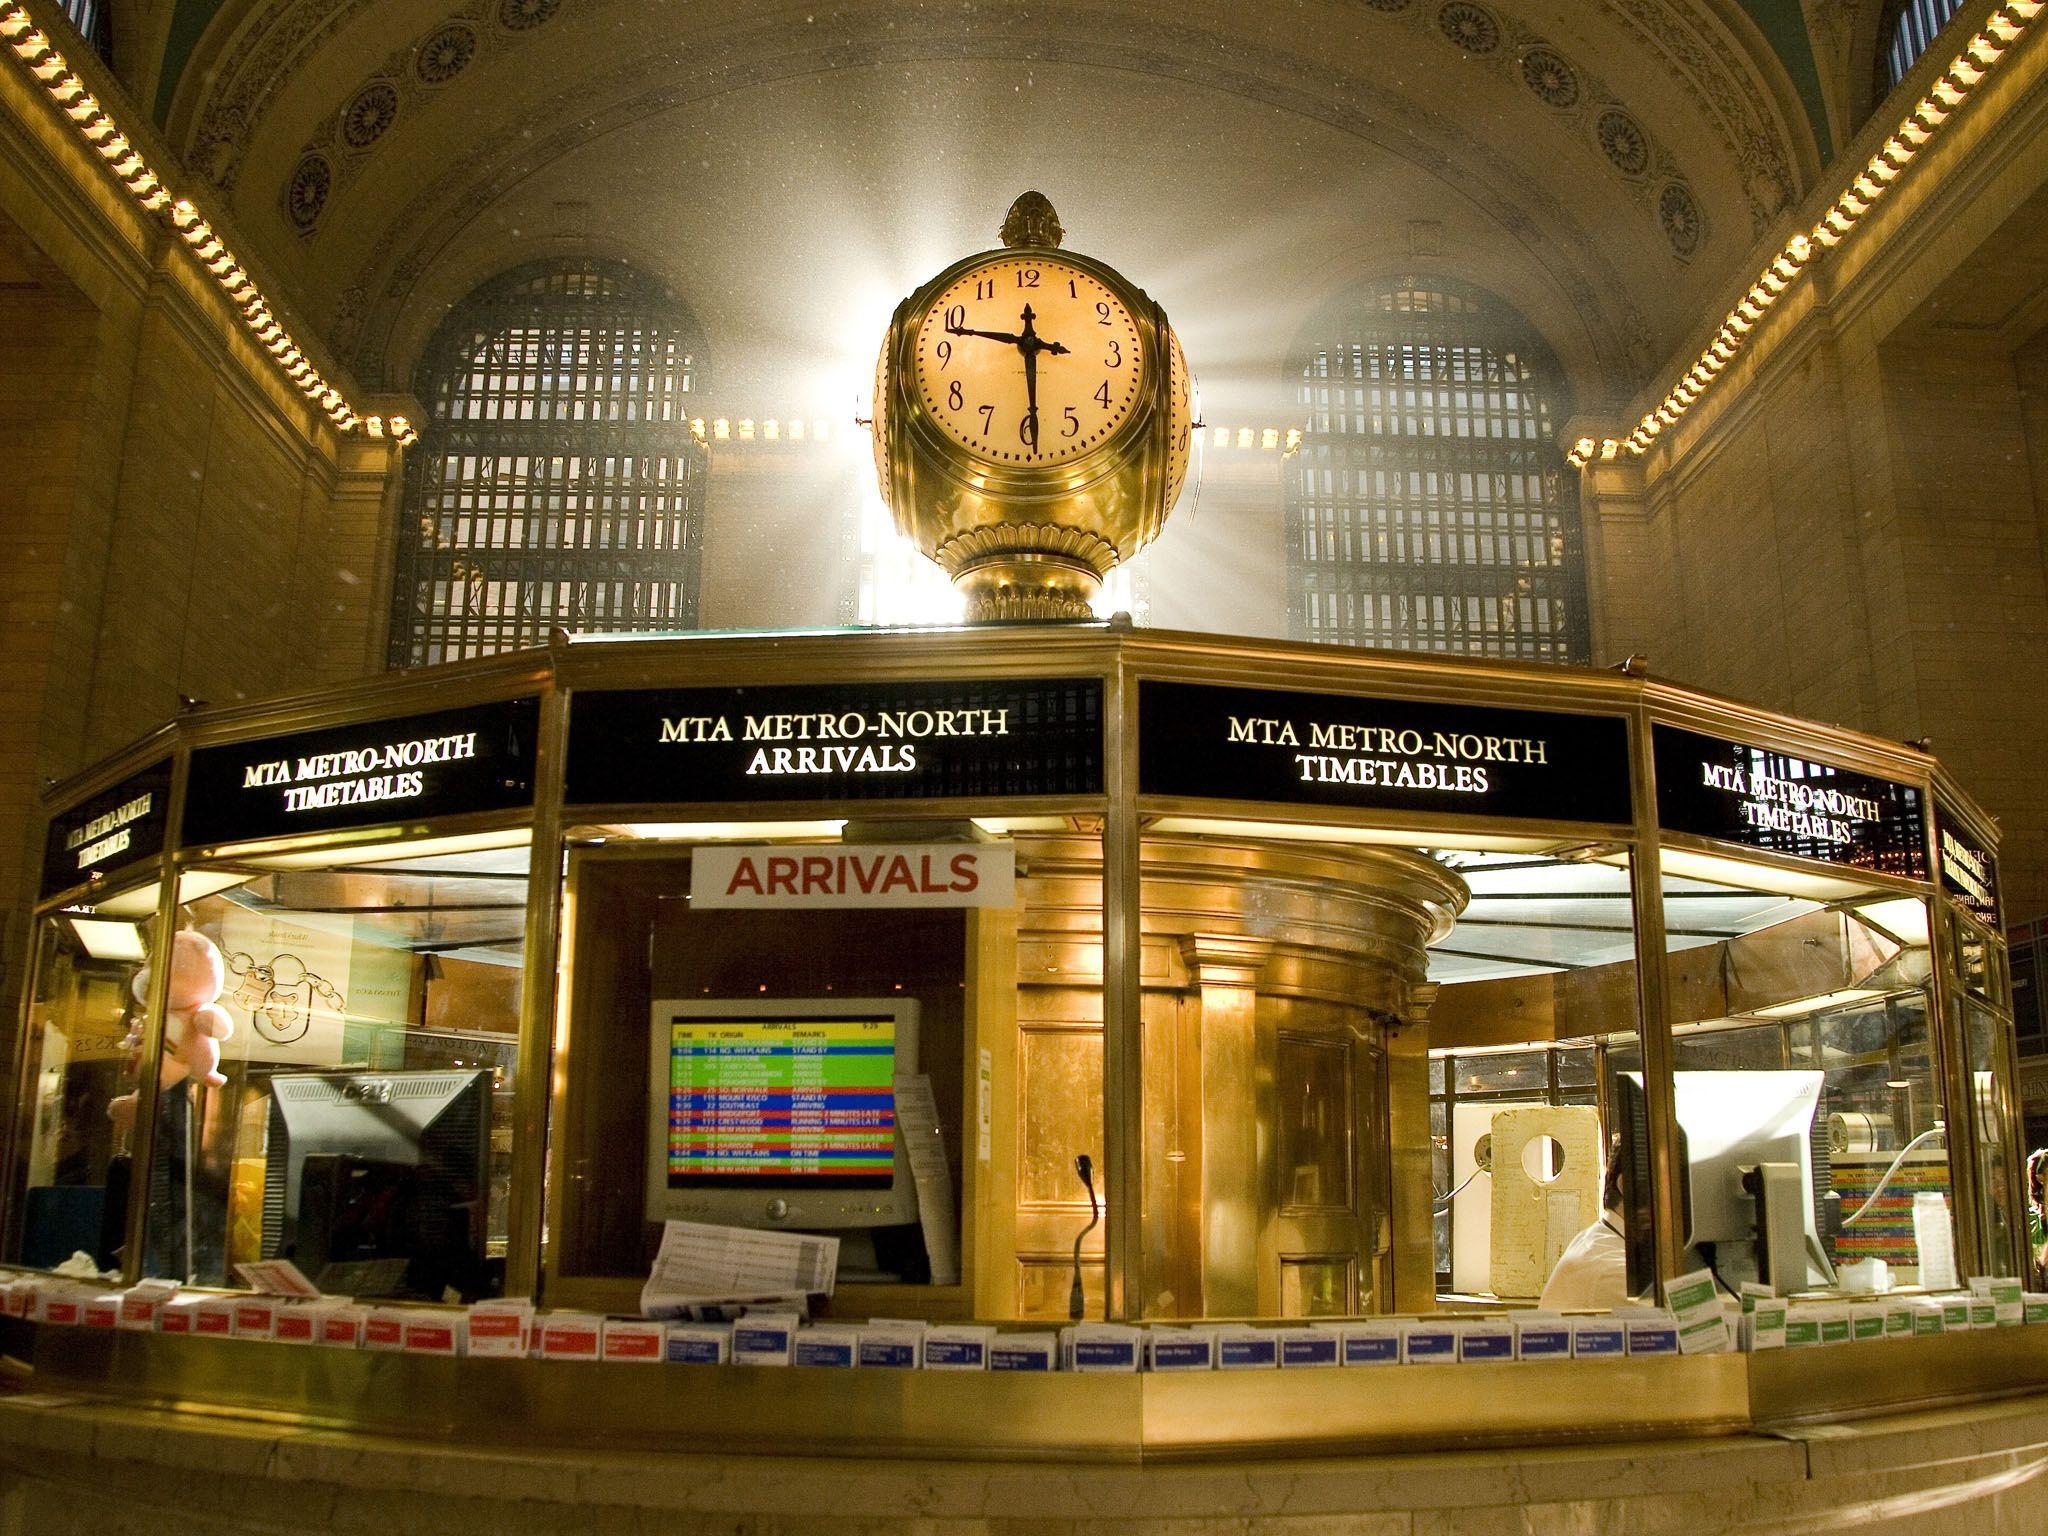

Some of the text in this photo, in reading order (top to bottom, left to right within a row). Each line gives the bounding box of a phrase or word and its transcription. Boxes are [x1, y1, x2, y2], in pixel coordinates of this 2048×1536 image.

[976, 279, 994, 301] 11
[1016, 269, 1039, 288] 12
[1068, 279, 1078, 299] 1
[944, 304, 965, 332] 10
[1096, 302, 1112, 326] 2
[936, 340, 952, 371] 9
[1104, 340, 1122, 368] 3
[948, 380, 964, 411] 8
[1094, 379, 1113, 409] 4
[978, 405, 995, 436] 7
[1061, 406, 1079, 438] 5
[659, 709, 1009, 743] MTA METRO-NORTH
[1227, 716, 1548, 764] MTA METRO-NORTH
[242, 732, 478, 788] MTA METRO-NORTH
[745, 744, 916, 775] ARRIVALS
[1294, 754, 1489, 793] TIMETABLES
[283, 771, 424, 813] TIMETABLES
[1702, 762, 1880, 823] MTA METRO-NORTH
[1742, 800, 1851, 845] TIMETABLES
[726, 854, 979, 896] ARRIVALS
[762, 1023, 797, 1031] ARRIVALS
[792, 1030, 826, 1038] REMARKS
[718, 1094, 744, 1102] MOUNT
[746, 1094, 768, 1102] KISCO
[791, 1094, 816, 1102] STAND
